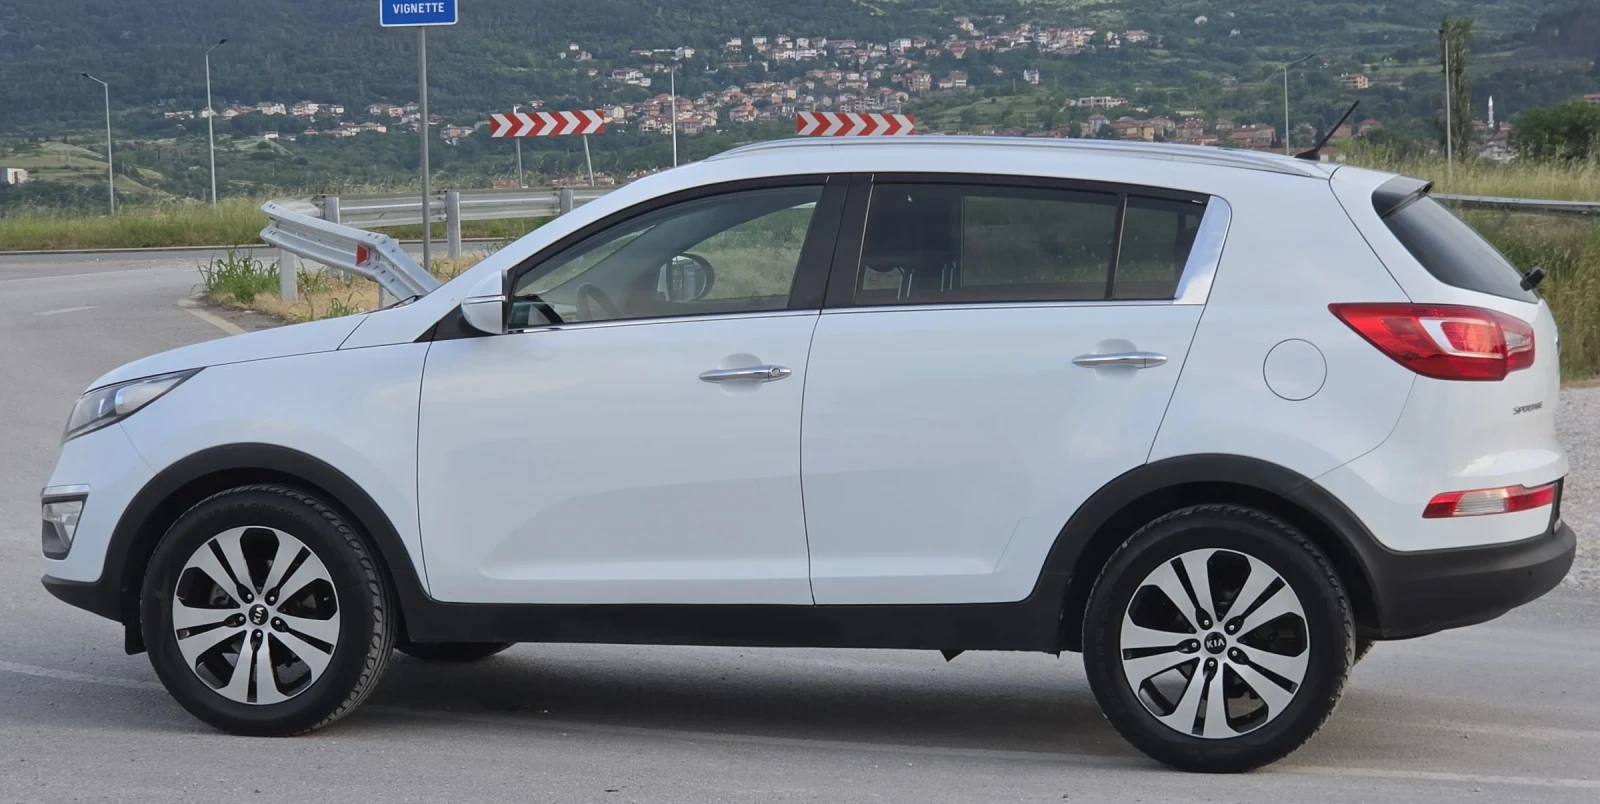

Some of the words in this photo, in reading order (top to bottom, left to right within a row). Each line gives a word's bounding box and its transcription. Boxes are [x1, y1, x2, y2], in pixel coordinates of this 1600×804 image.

[392, 2, 445, 14] VIGNETTE
[253, 607, 264, 624] KIA
[1206, 638, 1225, 649] KIA
